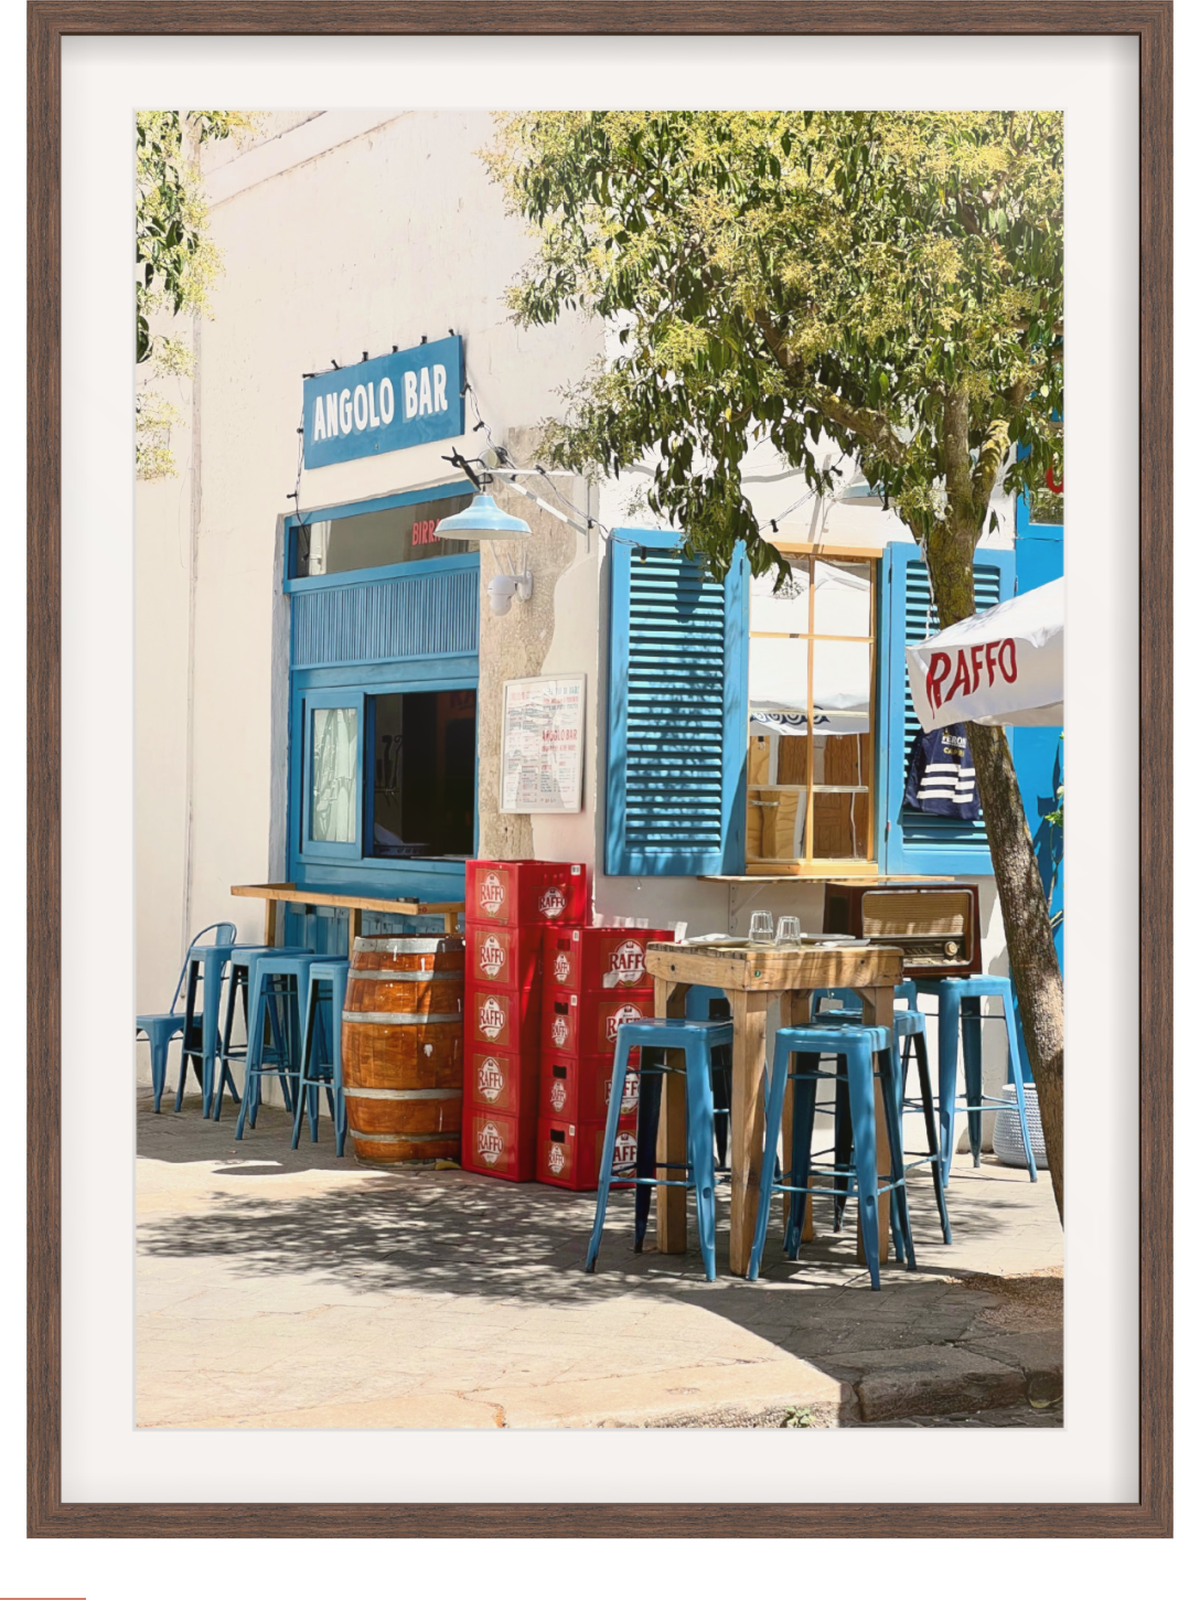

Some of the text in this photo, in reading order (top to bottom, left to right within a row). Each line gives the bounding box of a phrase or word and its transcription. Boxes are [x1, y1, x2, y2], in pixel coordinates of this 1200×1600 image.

[314, 364, 448, 441] ANGOLO BAR
[926, 638, 1017, 720] RAFFO
[481, 884, 504, 901] RAFFO
[540, 896, 565, 908] RAFFO
[480, 946, 504, 964] RAFFO
[480, 1008, 504, 1027] RAFFO
[479, 1069, 503, 1089] RAFFO
[478, 1132, 503, 1152] RAFFO
